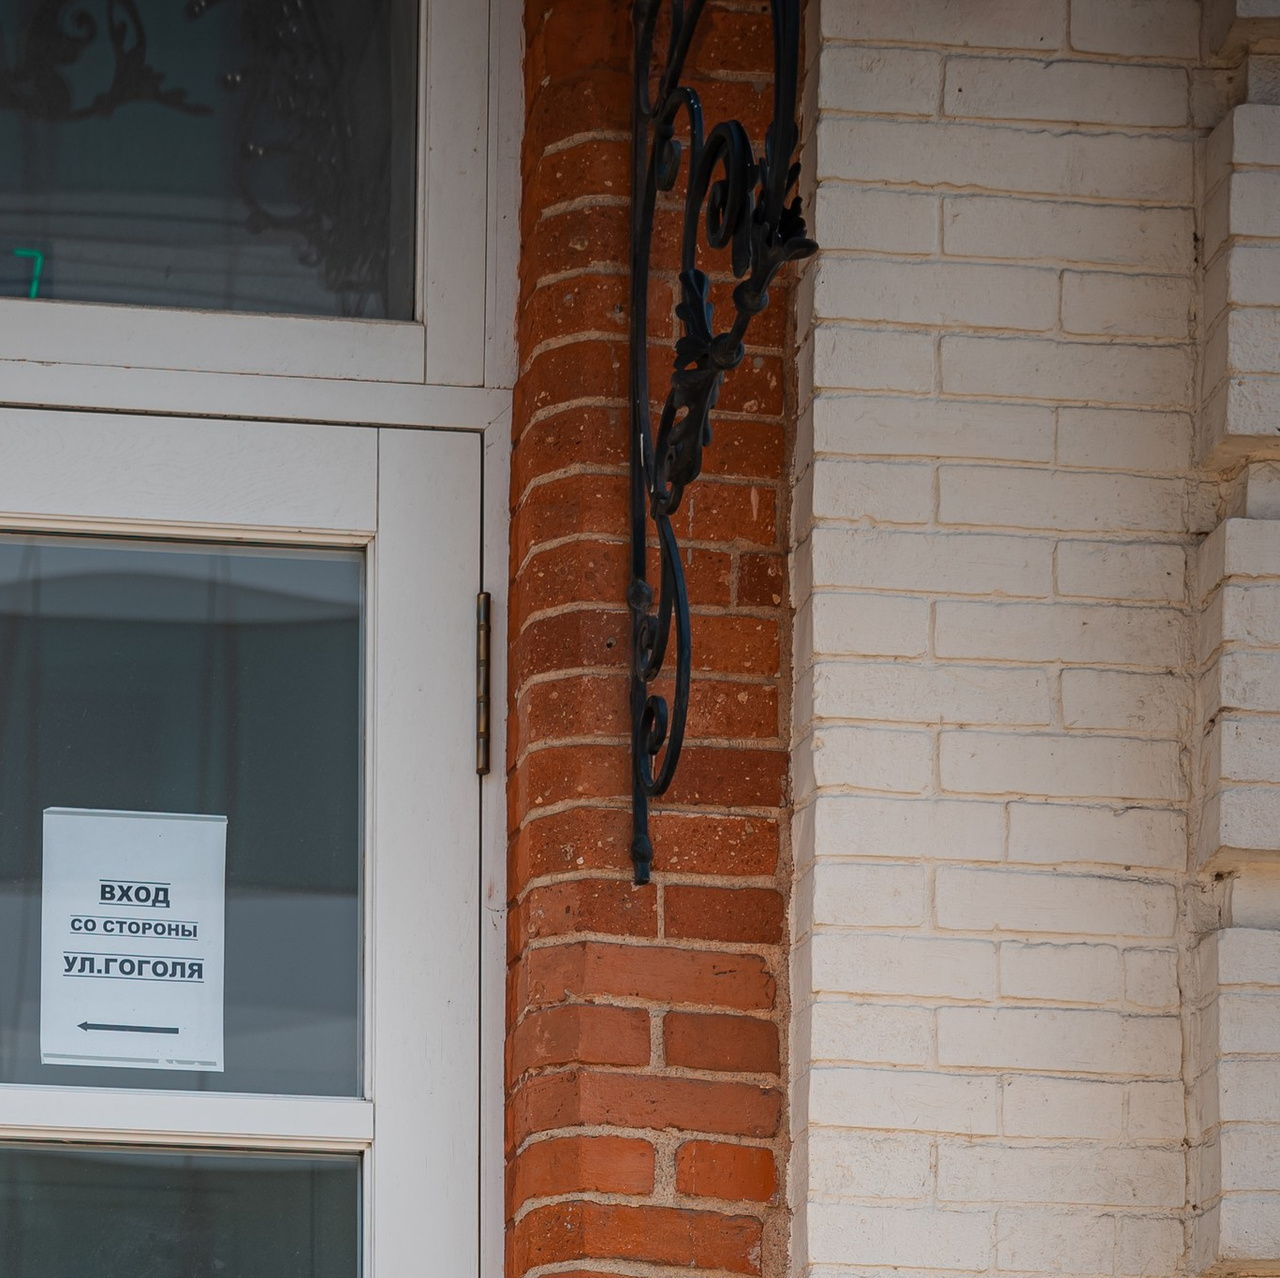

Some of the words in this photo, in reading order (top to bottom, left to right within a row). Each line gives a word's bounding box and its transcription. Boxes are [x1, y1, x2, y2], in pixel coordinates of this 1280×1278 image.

[100, 884, 170, 908] ВХОД
[70, 917, 97, 932] СО
[103, 920, 198, 938] СТОРОНЫ
[63, 955, 203, 980] УЛ.ГОГОЛЯ
